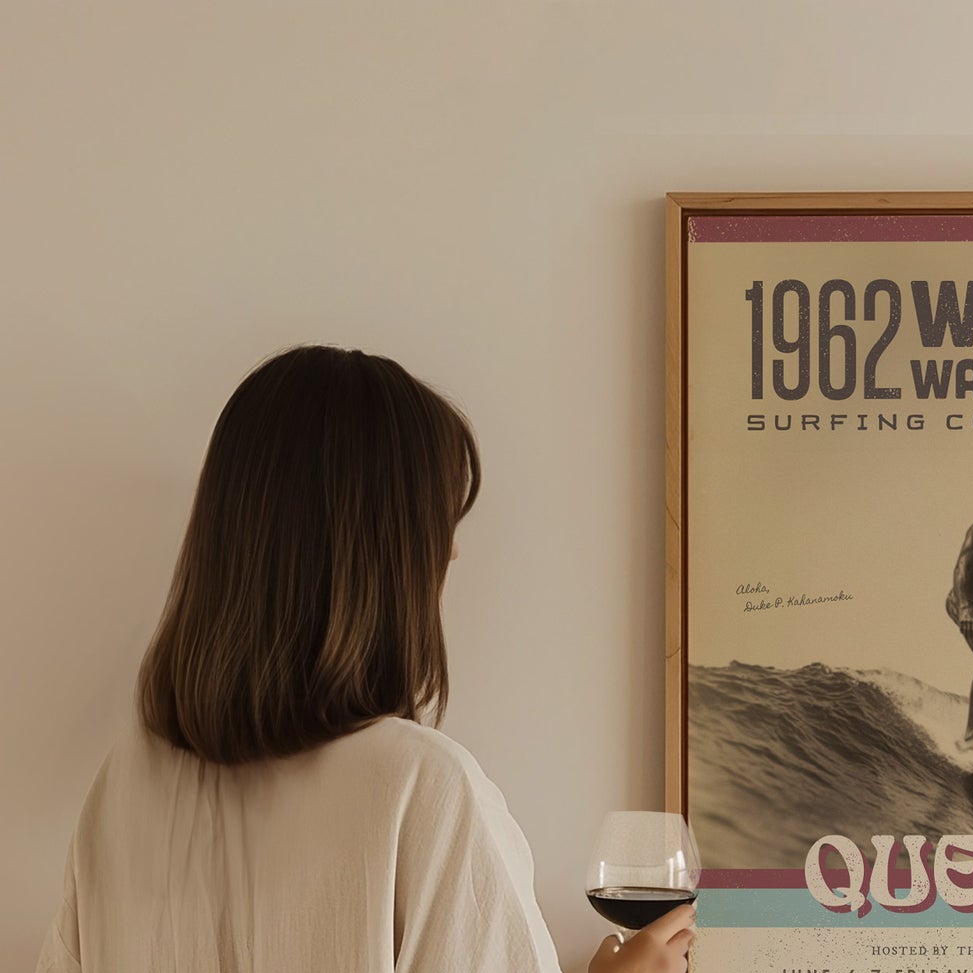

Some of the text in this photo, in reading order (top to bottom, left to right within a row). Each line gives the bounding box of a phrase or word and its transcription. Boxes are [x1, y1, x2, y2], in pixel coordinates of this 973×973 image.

[745, 279, 902, 400] 1962
[746, 413, 926, 431] SURFING
[736, 582, 770, 595] Aloha,
[744, 600, 774, 612] Duke
[872, 946, 927, 956] HOSTED
[932, 946, 949, 956] BY
